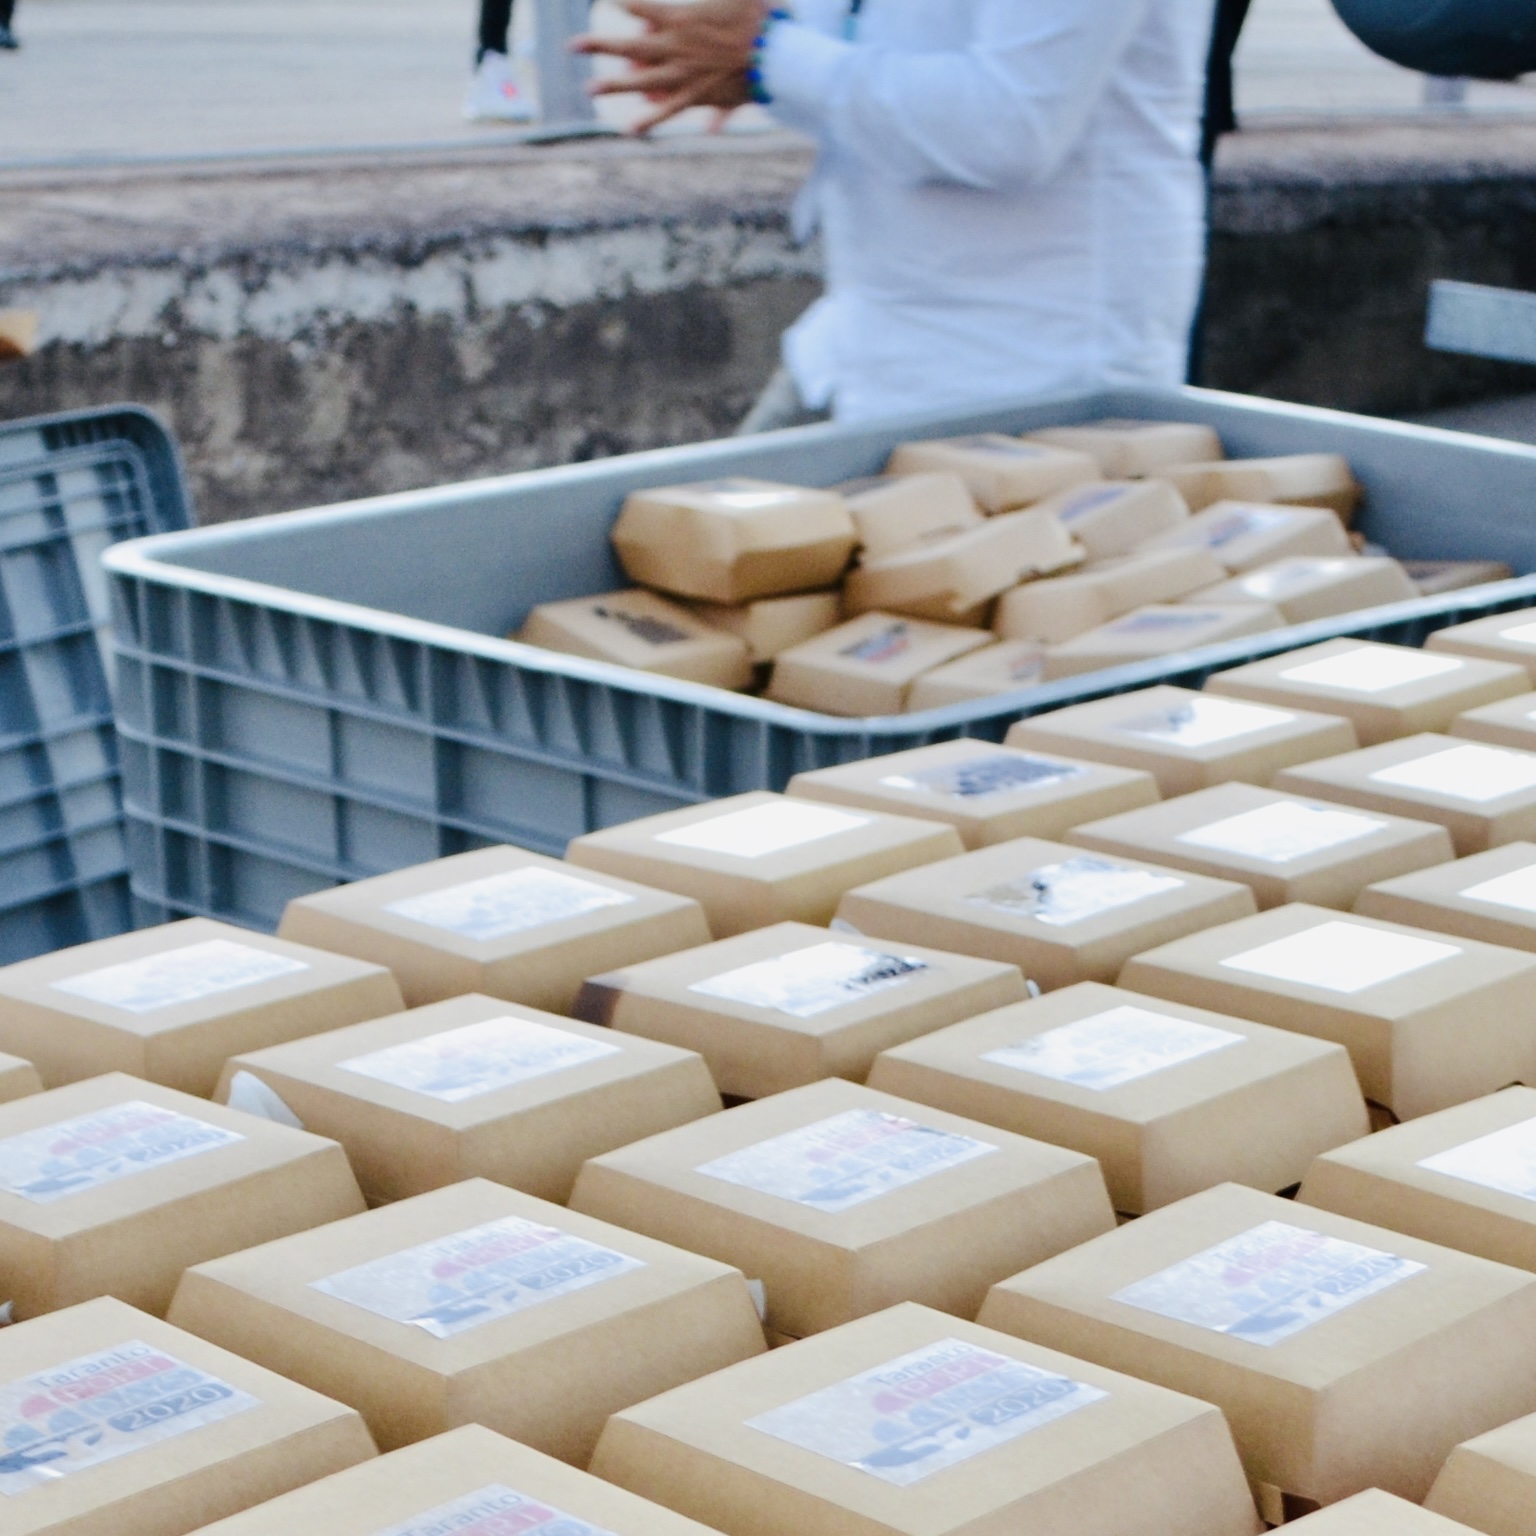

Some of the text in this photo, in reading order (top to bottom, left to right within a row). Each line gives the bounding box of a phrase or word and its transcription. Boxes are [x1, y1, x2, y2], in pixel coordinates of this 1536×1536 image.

[34, 1346, 149, 1385] Taranto
[869, 1345, 973, 1386] Taranto
[127, 1383, 224, 1427] 2020
[978, 1379, 1070, 1424] 2020
